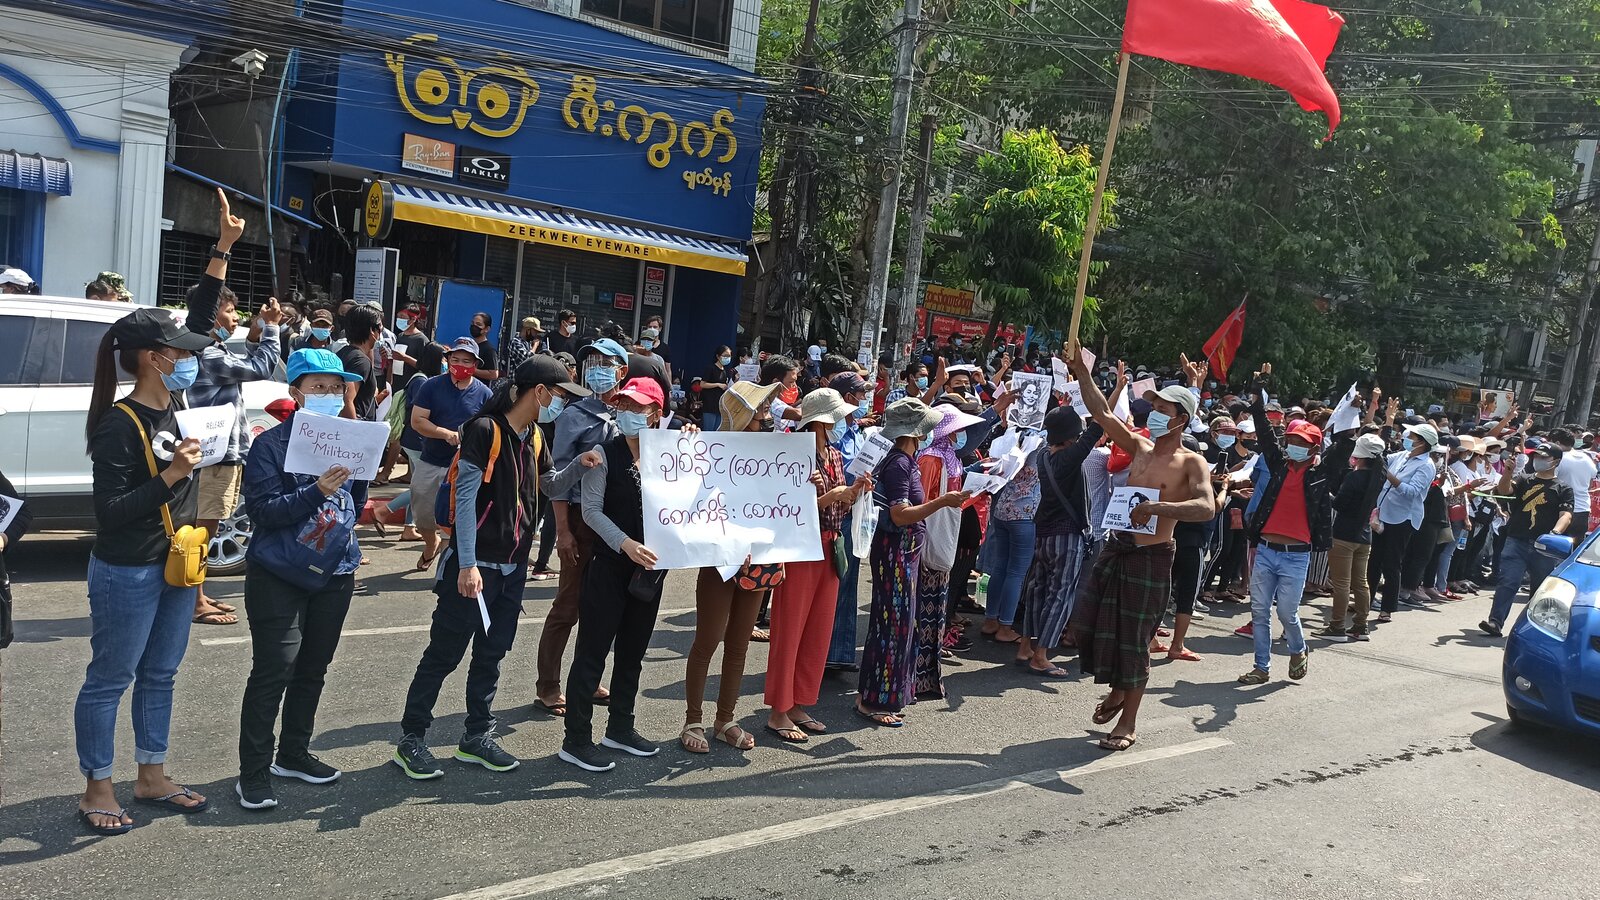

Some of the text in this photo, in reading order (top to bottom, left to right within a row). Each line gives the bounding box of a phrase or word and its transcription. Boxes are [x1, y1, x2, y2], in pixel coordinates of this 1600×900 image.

[463, 166, 507, 180] OAKLEY
[291, 198, 302, 208] 34
[508, 224, 650, 256] ZEEKWEK EYEWARE
[298, 422, 342, 445] Reject
[313, 443, 365, 463] Military
[1106, 513, 1122, 521] FREE
